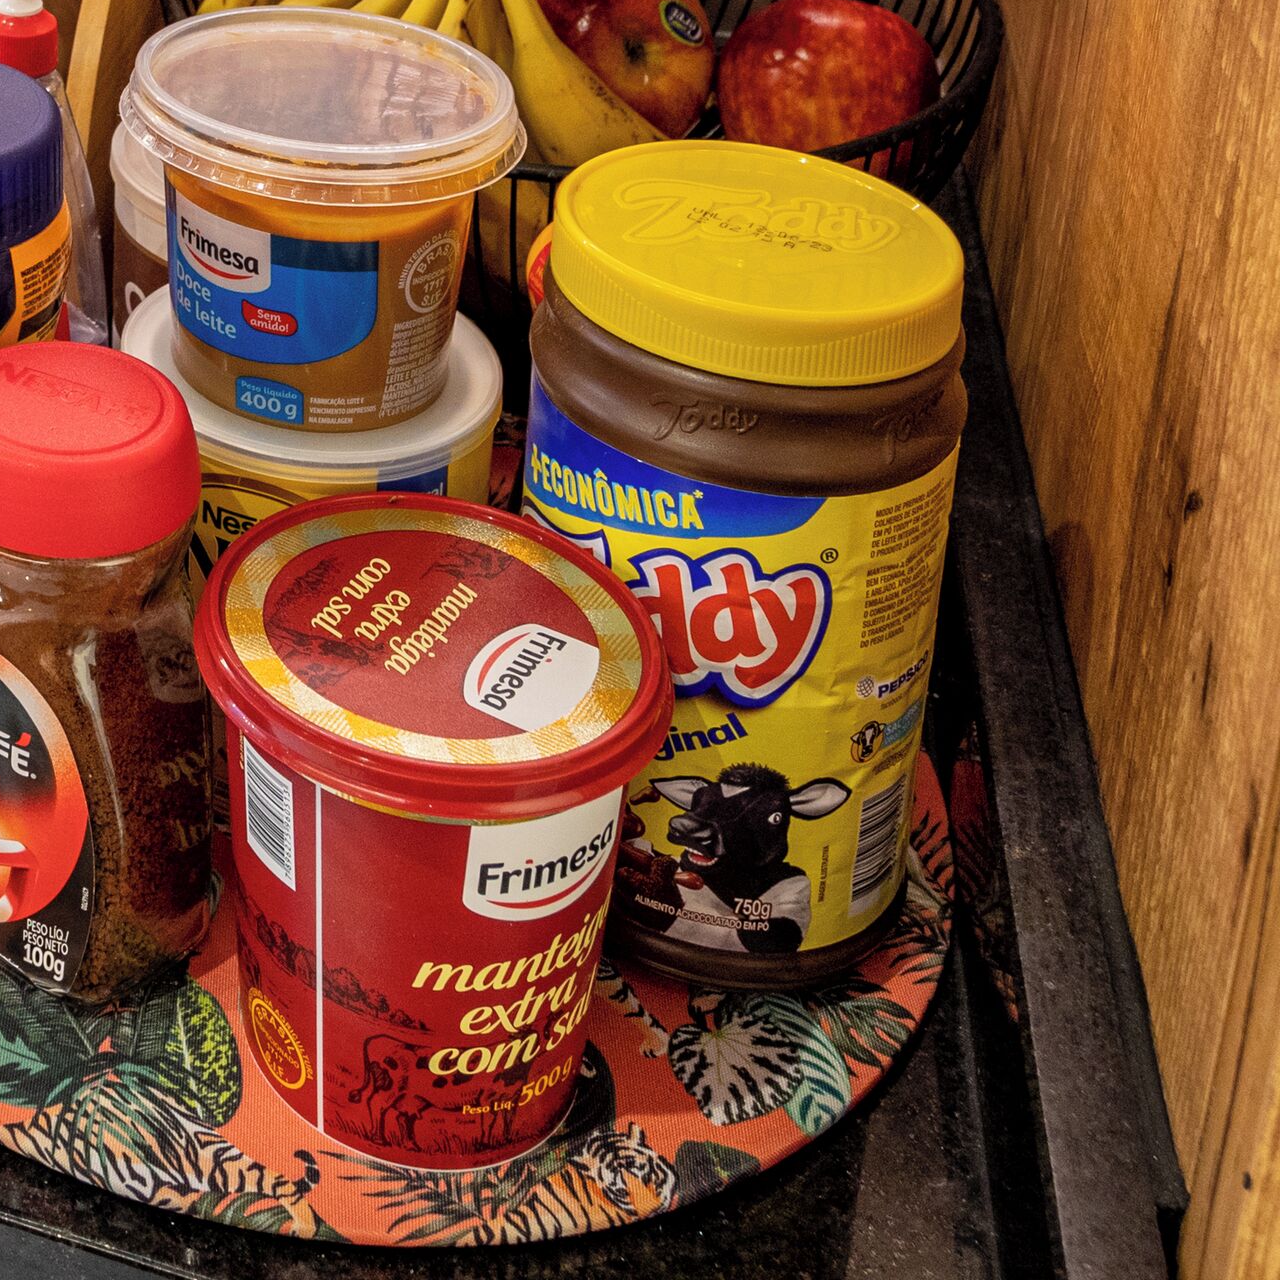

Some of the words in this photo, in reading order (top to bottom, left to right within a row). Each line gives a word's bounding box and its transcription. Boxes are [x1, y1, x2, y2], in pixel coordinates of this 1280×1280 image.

[612, 178, 902, 253] Toddy
[180, 215, 260, 276] Frimesa
[176, 260, 212, 303] Doce
[176, 286, 192, 313] de
[195, 298, 238, 339] leite
[249, 316, 290, 333] amido!
[256, 308, 282, 324] Sem
[240, 379, 262, 394] Peso
[263, 384, 298, 401] líquido
[240, 391, 282, 414] 400
[285, 402, 298, 421] g
[651, 400, 759, 441] Toddy
[880, 534, 897, 548] LEITE
[341, 556, 393, 601] com
[310, 595, 353, 639] sal
[353, 589, 412, 642] extra
[383, 582, 479, 677] manteiga
[639, 562, 818, 690] ddy
[859, 638, 869, 649] DO
[869, 633, 884, 646] PESO
[479, 631, 568, 712] Frimesa
[476, 819, 616, 896] Frimesa
[26, 918, 48, 937] PESO
[634, 893, 675, 916] ALIMENTO
[675, 908, 742, 931] ACHOCOLATADO
[742, 920, 756, 931] EM
[756, 919, 770, 932] PÓ
[733, 897, 773, 920] 750g
[22, 929, 44, 948] PESO
[44, 936, 69, 956] NETO
[22, 942, 66, 983] 100g
[427, 1032, 541, 1076] com
[544, 960, 600, 1053] sal
[458, 971, 579, 1036] extra
[461, 1103, 490, 1116] Peso
[493, 1099, 516, 1113] Líq.
